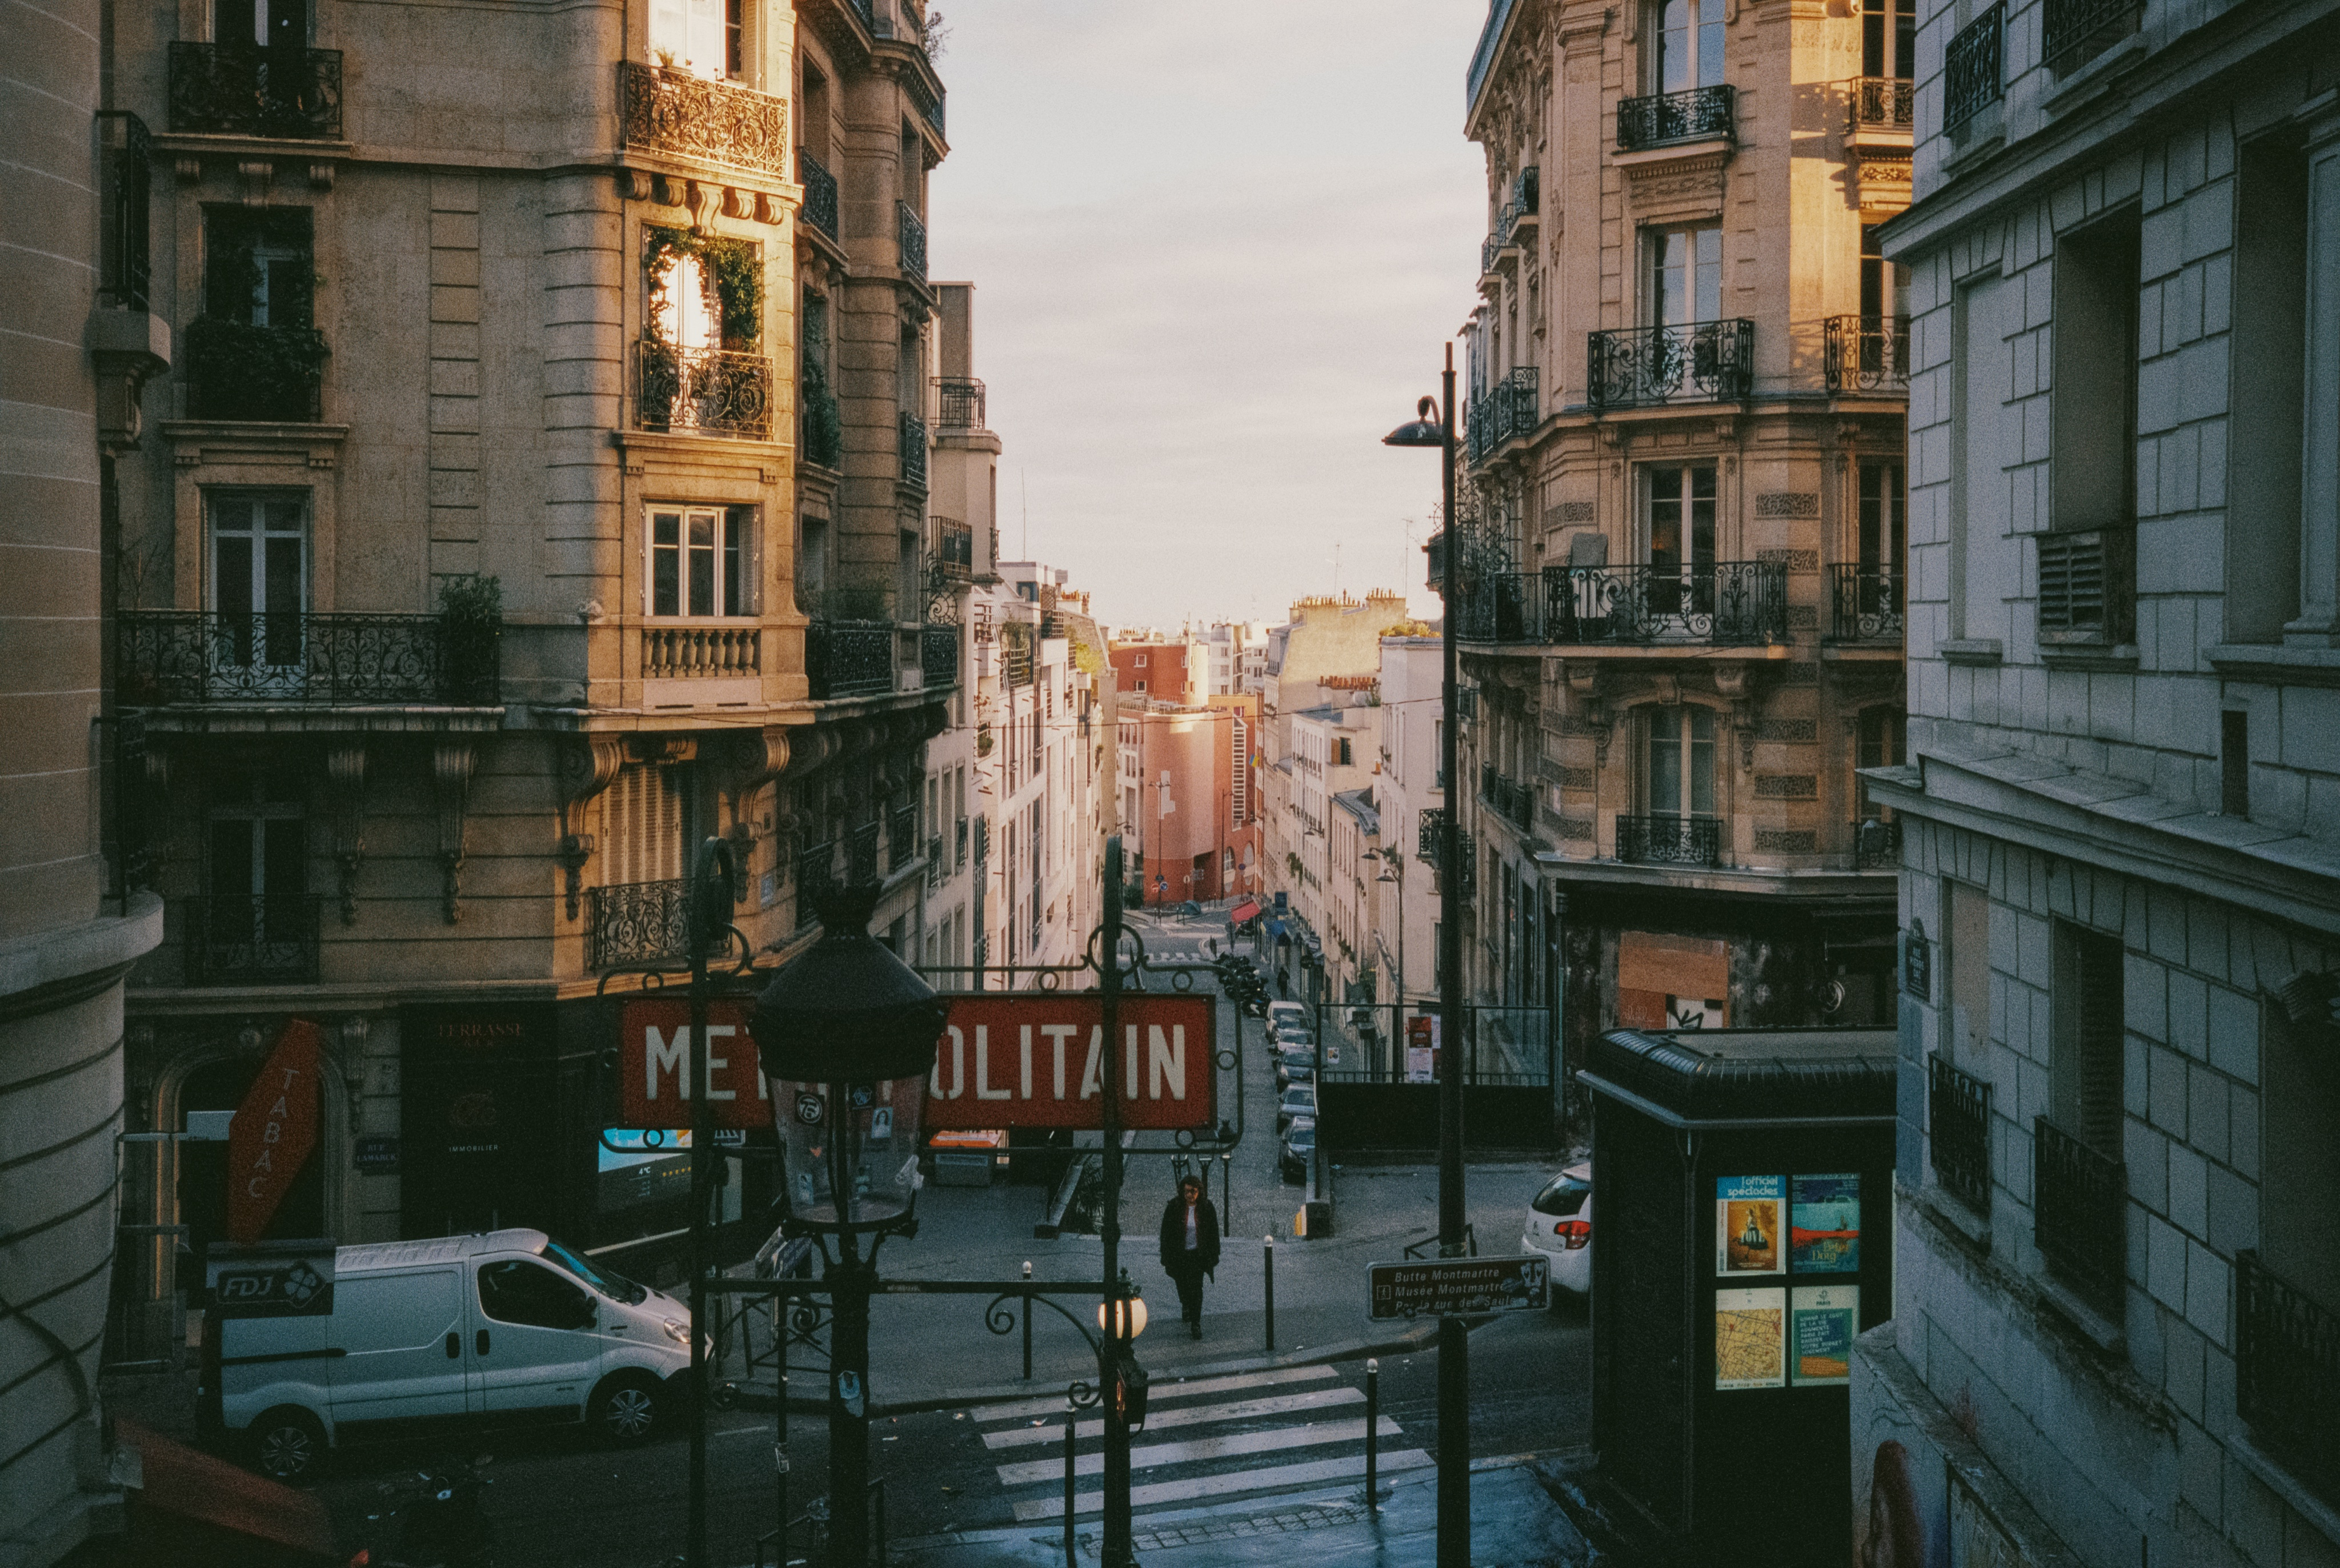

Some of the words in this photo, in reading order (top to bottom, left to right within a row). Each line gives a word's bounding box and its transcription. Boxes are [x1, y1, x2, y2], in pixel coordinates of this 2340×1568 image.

[646, 1024, 1185, 1100] MEOLITAIN
[247, 1068, 300, 1198] TABAC
[638, 1166, 651, 1175] 4°C
[1728, 1186, 1778, 1198] spectacles
[1395, 1272, 1426, 1283] Butte
[1432, 1269, 1499, 1281] Montmartre
[223, 1276, 274, 1297] FDJ
[1395, 1285, 1433, 1297] Musée
